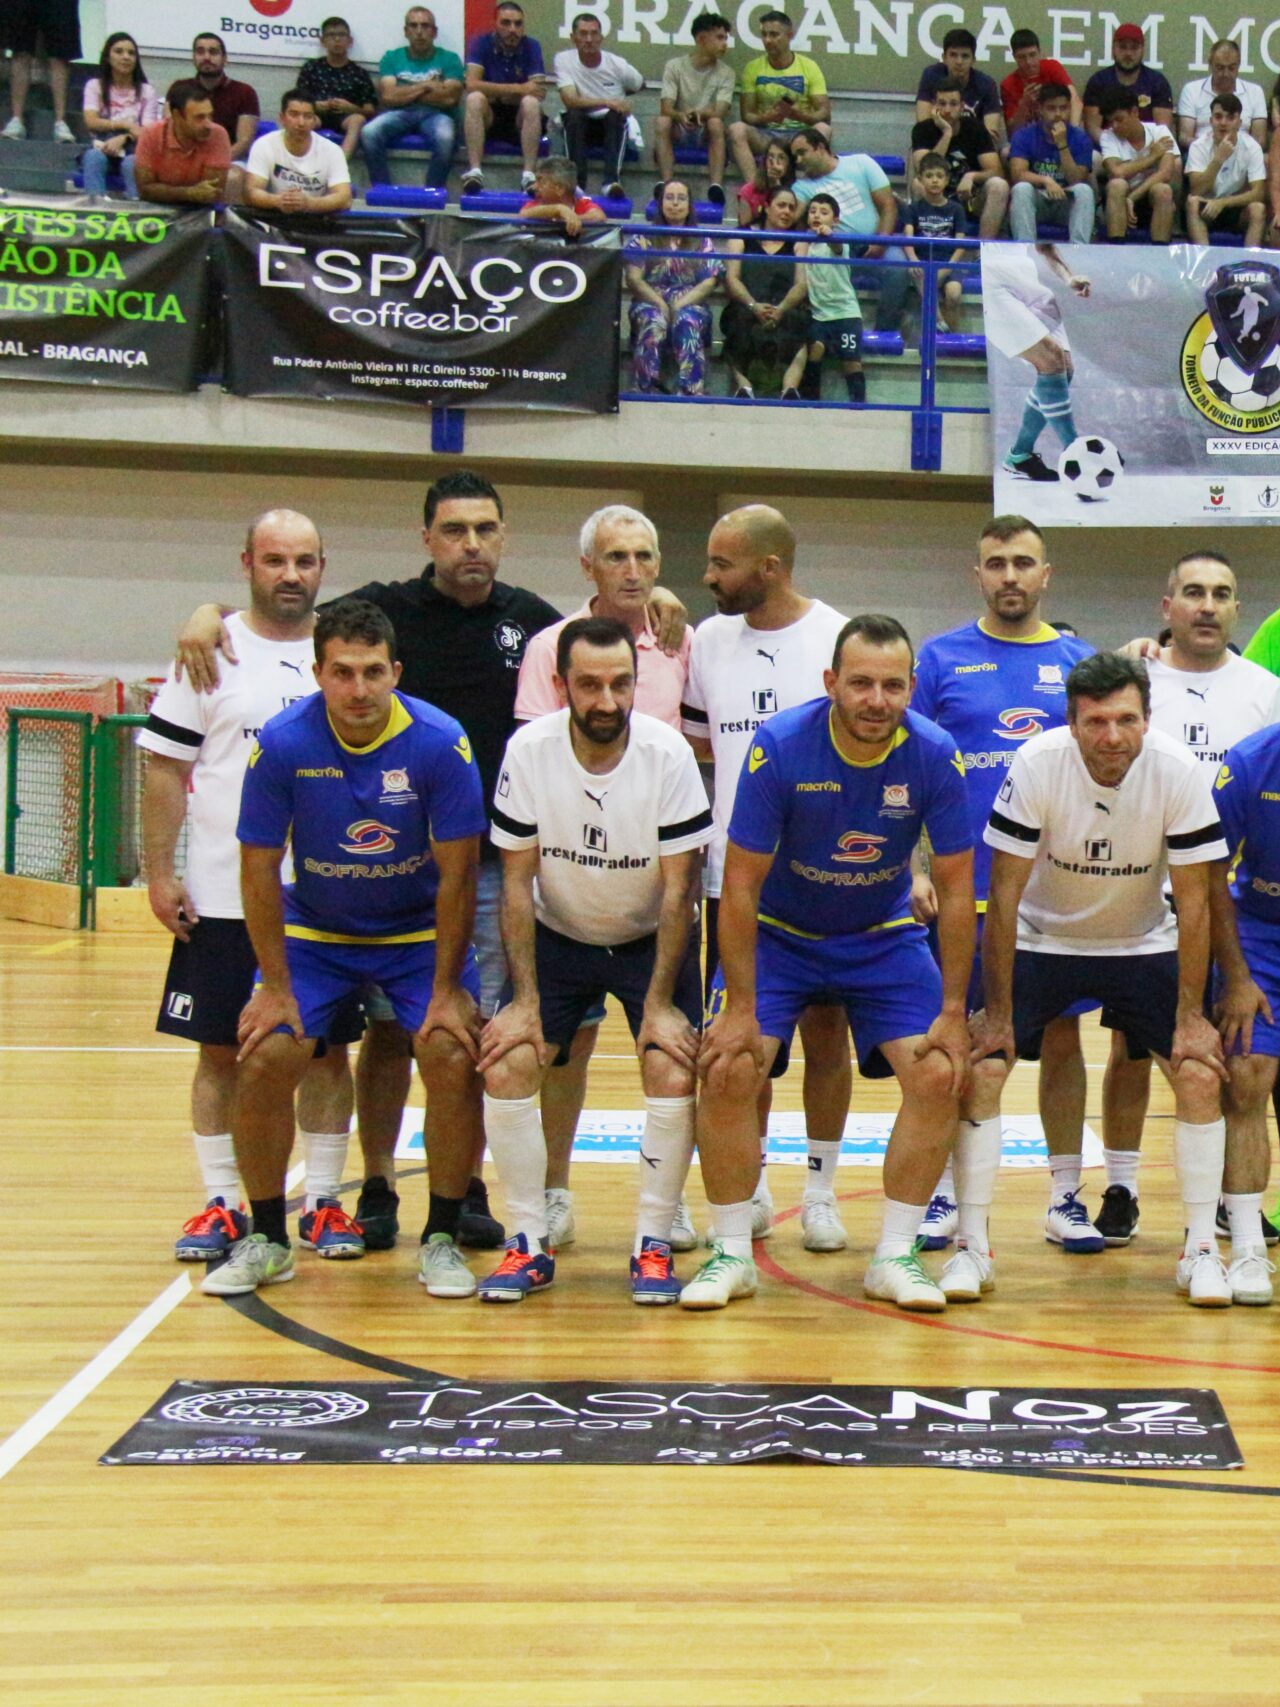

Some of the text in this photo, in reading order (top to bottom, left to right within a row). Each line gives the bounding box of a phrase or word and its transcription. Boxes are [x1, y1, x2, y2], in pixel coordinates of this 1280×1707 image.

[220, 17, 321, 40] Bragança
[1047, 9, 1165, 70] EM
[84, 211, 167, 244] SÃO
[66, 248, 127, 281] DA
[258, 242, 588, 313] ESPAÇO
[0, 281, 188, 323] ISTÊNCIA
[328, 301, 519, 333] coffeebar
[841, 333, 857, 350] 95
[43, 343, 149, 368] BRAGANÇA
[272, 356, 567, 382] Rua Padre António Vieira N1 R/C Direito 5300-114 Bragança
[405, 377, 489, 390] espaco.coffeebar
[1185, 354, 1202, 395] TORNEIO
[1208, 405, 1244, 428] FUNÇÃO
[1212, 442, 1242, 451] XXXV
[955, 662, 998, 675] macron
[963, 750, 1017, 770] SOFR
[295, 766, 344, 779] macron
[795, 780, 841, 793] macron
[541, 846, 651, 870] restaurador
[1047, 852, 1153, 876] restaurador
[387, 1417, 654, 1430] PETISCOS
